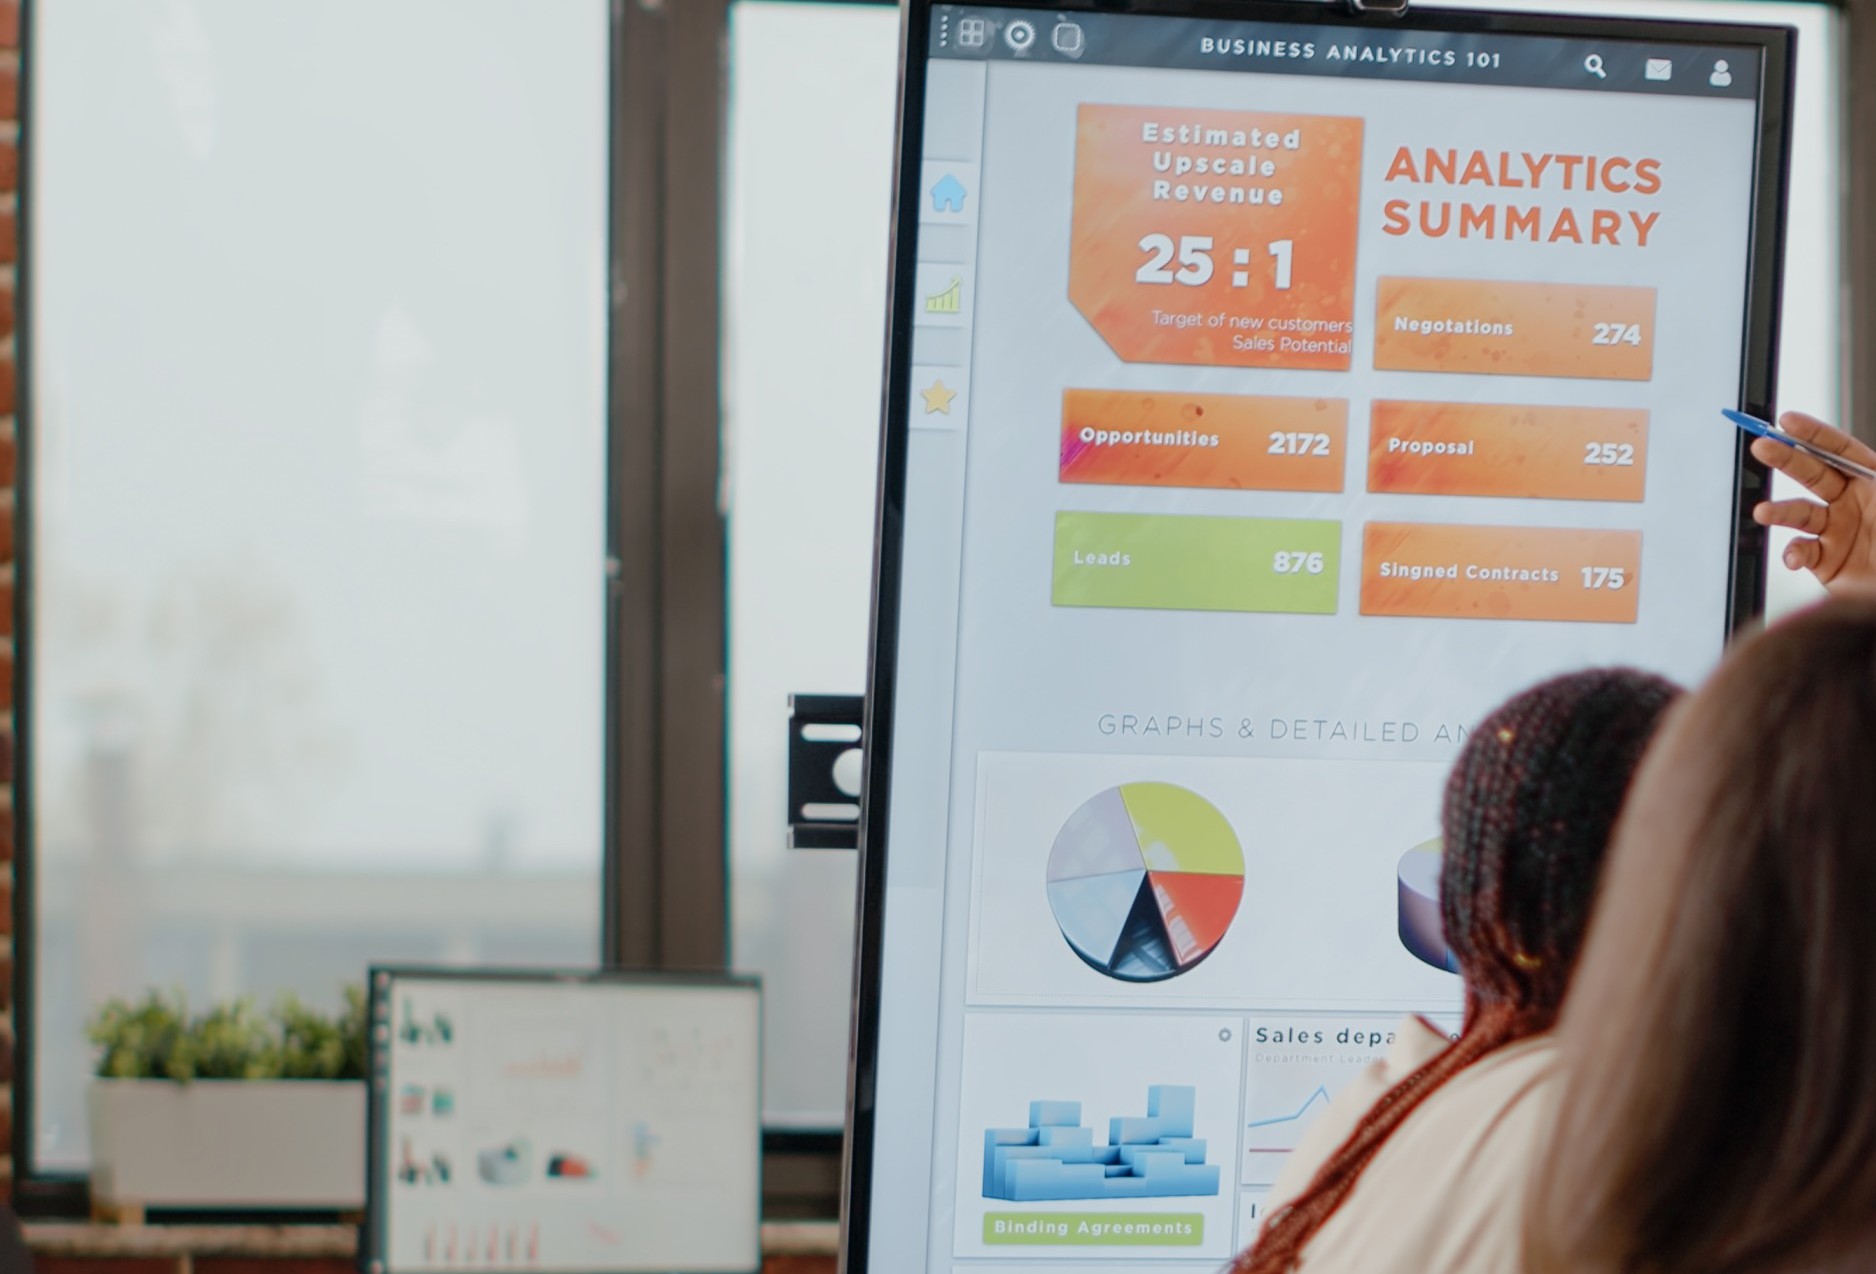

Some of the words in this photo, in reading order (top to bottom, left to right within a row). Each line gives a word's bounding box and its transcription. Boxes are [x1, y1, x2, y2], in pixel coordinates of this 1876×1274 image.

[1200, 37, 1316, 59] BUSINESS
[1326, 45, 1456, 66] ANALYTICS
[1466, 50, 1501, 69] 101
[1142, 122, 1301, 151] Estimated
[1153, 151, 1276, 177] Upscale
[1384, 146, 1662, 195] ANALYTICS
[1153, 179, 1284, 206] Revenue
[1382, 199, 1661, 247] SUMMARY
[1134, 233, 1214, 287] 25
[1268, 239, 1293, 290] 1
[1152, 310, 1204, 328] Target
[1208, 311, 1226, 328] of
[1230, 317, 1264, 330] new
[1268, 318, 1353, 334] customers
[1394, 316, 1514, 337] Negotations
[1232, 335, 1275, 352] Sales
[1280, 337, 1352, 355] Potential
[1592, 322, 1641, 347] 274
[1080, 427, 1220, 448] Opportunities
[1268, 432, 1330, 456] 2172
[1389, 437, 1474, 456] Proposal
[1585, 442, 1634, 466] 252
[1073, 549, 1131, 568] Leads
[1272, 550, 1324, 575] 876
[1380, 562, 1458, 581] Singned
[1465, 565, 1559, 583] Contracts
[1581, 565, 1624, 591] 175
[1098, 713, 1224, 738] GRAPHS
[1237, 717, 1255, 738] &
[1270, 718, 1419, 743] DETAILED
[1255, 1026, 1324, 1044] Sales
[994, 1219, 1069, 1237] Binding
[1077, 1220, 1192, 1237] Agreements
